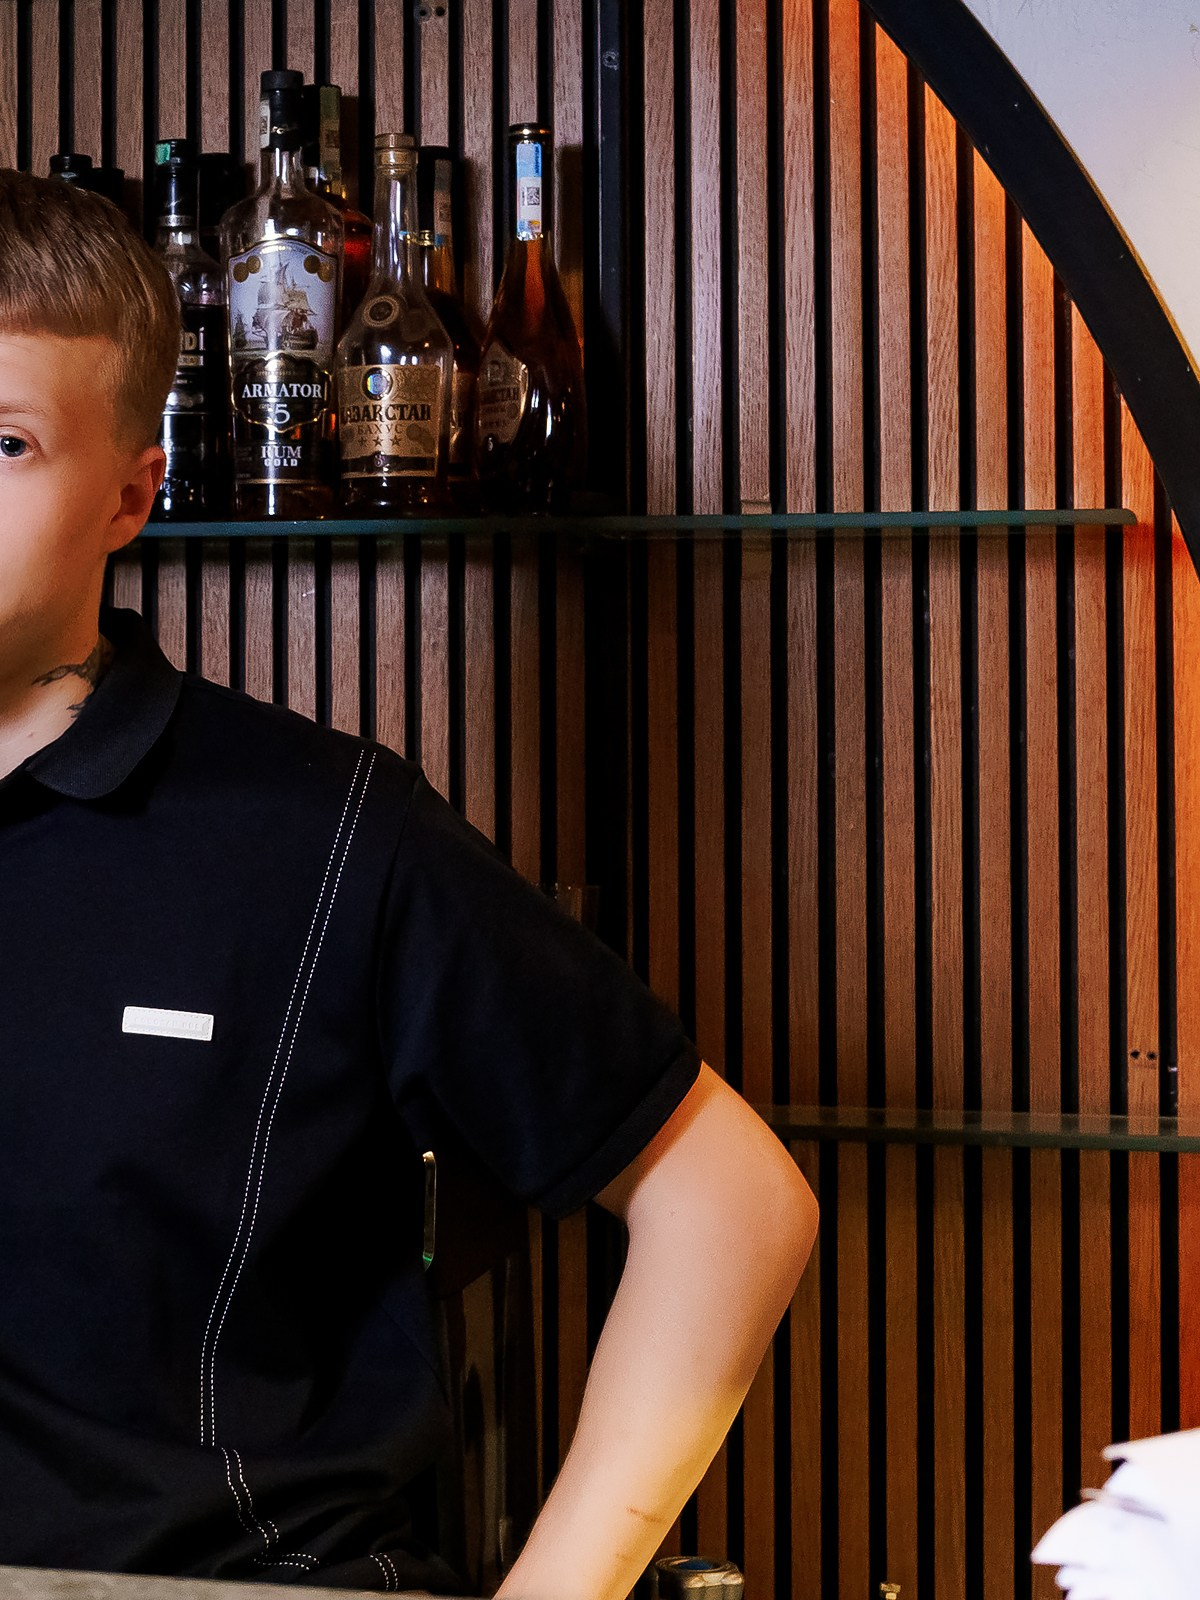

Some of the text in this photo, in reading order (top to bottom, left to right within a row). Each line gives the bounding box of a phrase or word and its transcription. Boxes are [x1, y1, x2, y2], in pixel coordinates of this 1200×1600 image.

[241, 383, 323, 398] ARMATOR
[274, 402, 291, 424] 5
[261, 446, 302, 459] RUM
[264, 459, 299, 467] GOLD
